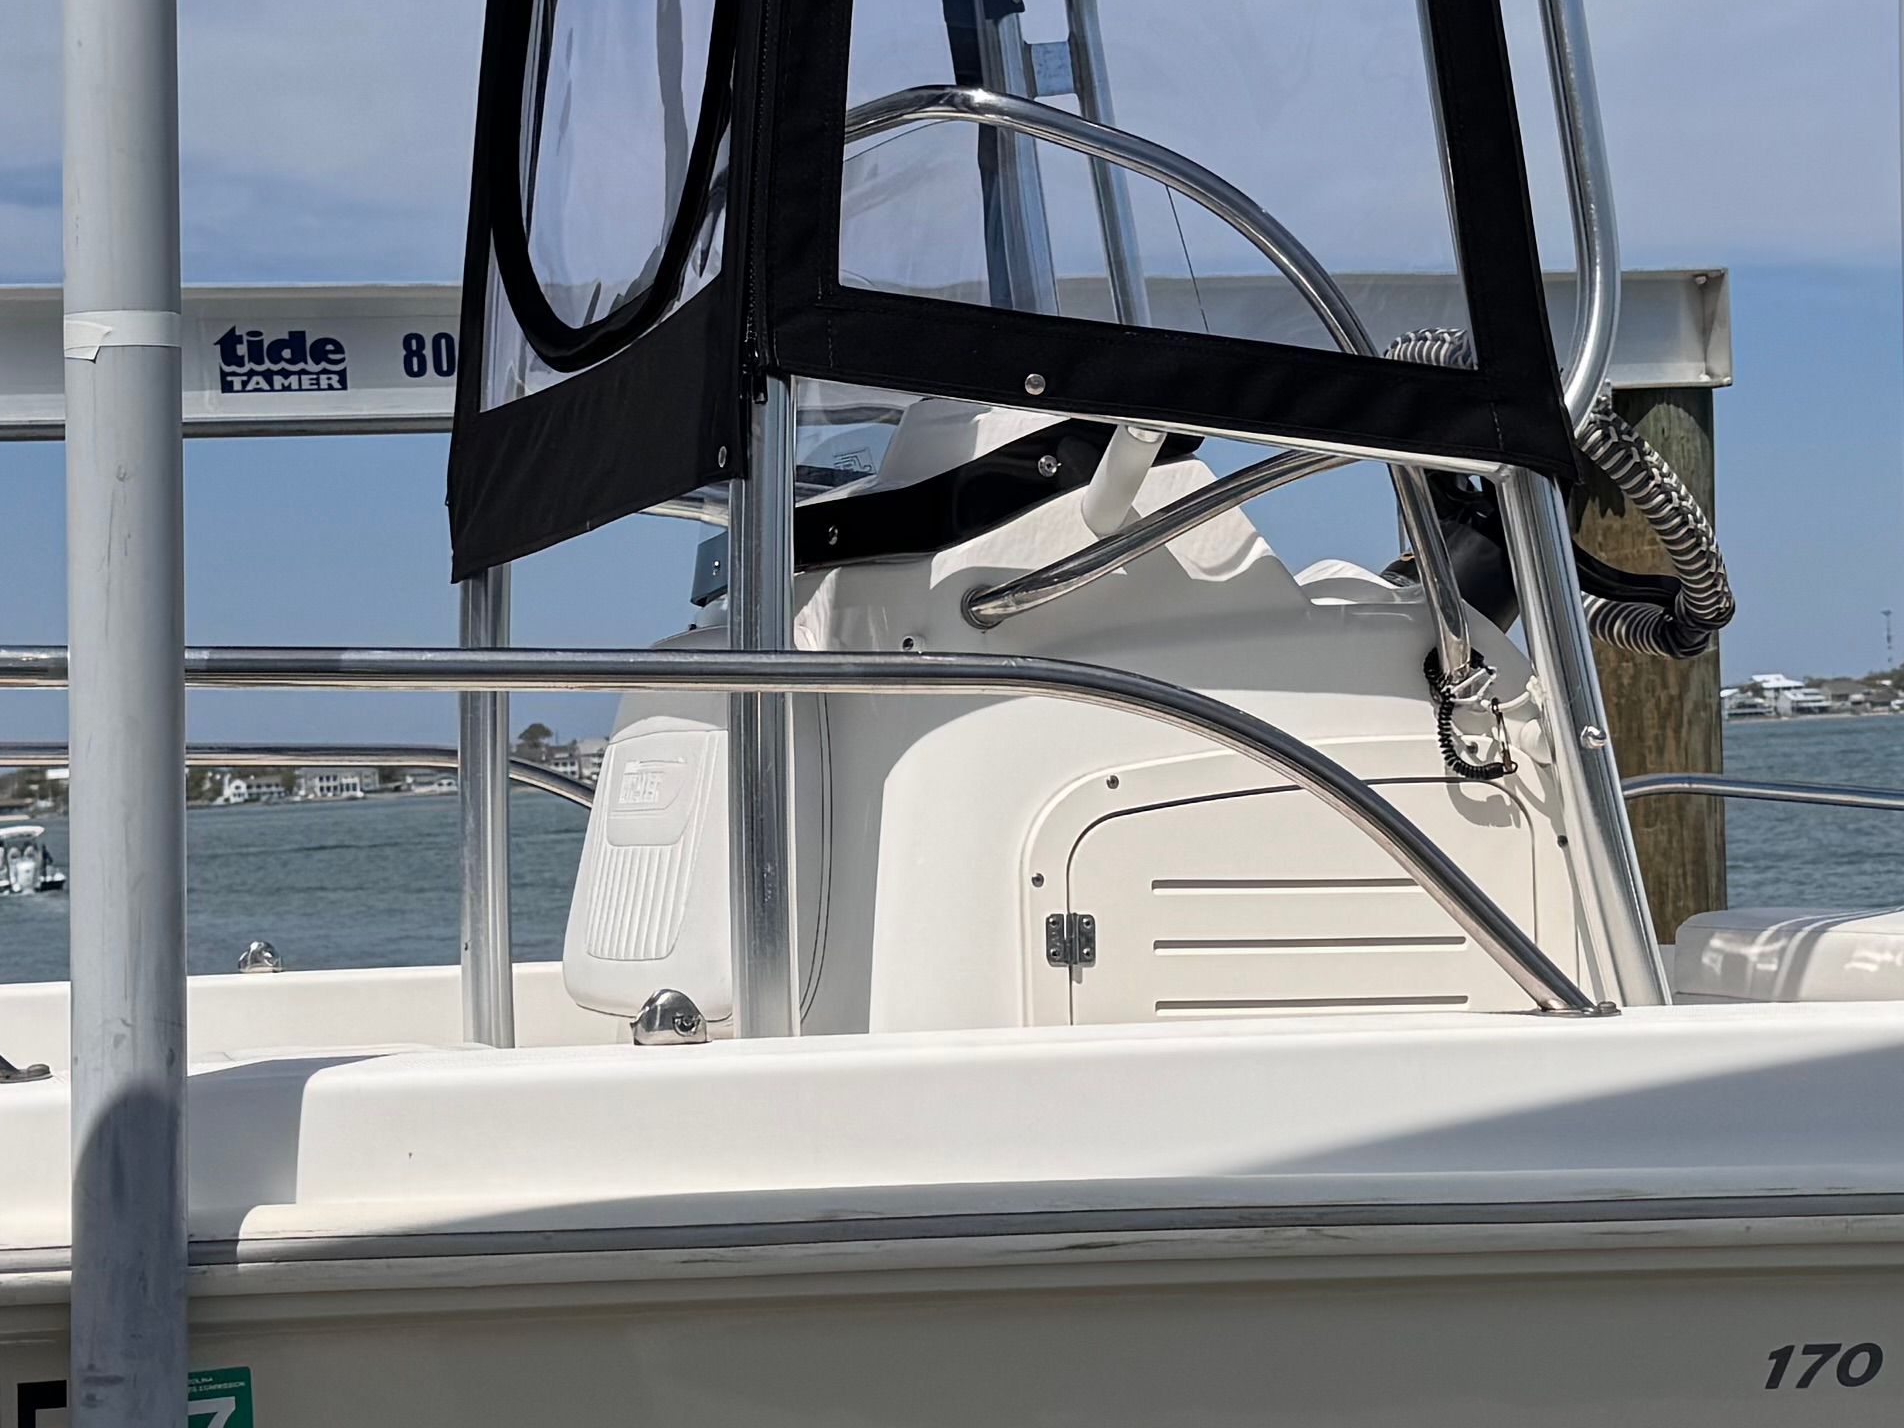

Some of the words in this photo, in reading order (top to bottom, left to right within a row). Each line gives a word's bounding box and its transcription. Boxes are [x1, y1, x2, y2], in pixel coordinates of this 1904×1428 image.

[213, 325, 346, 366] tide
[226, 373, 343, 392] TAMER
[1764, 1342, 1884, 1390] 170
